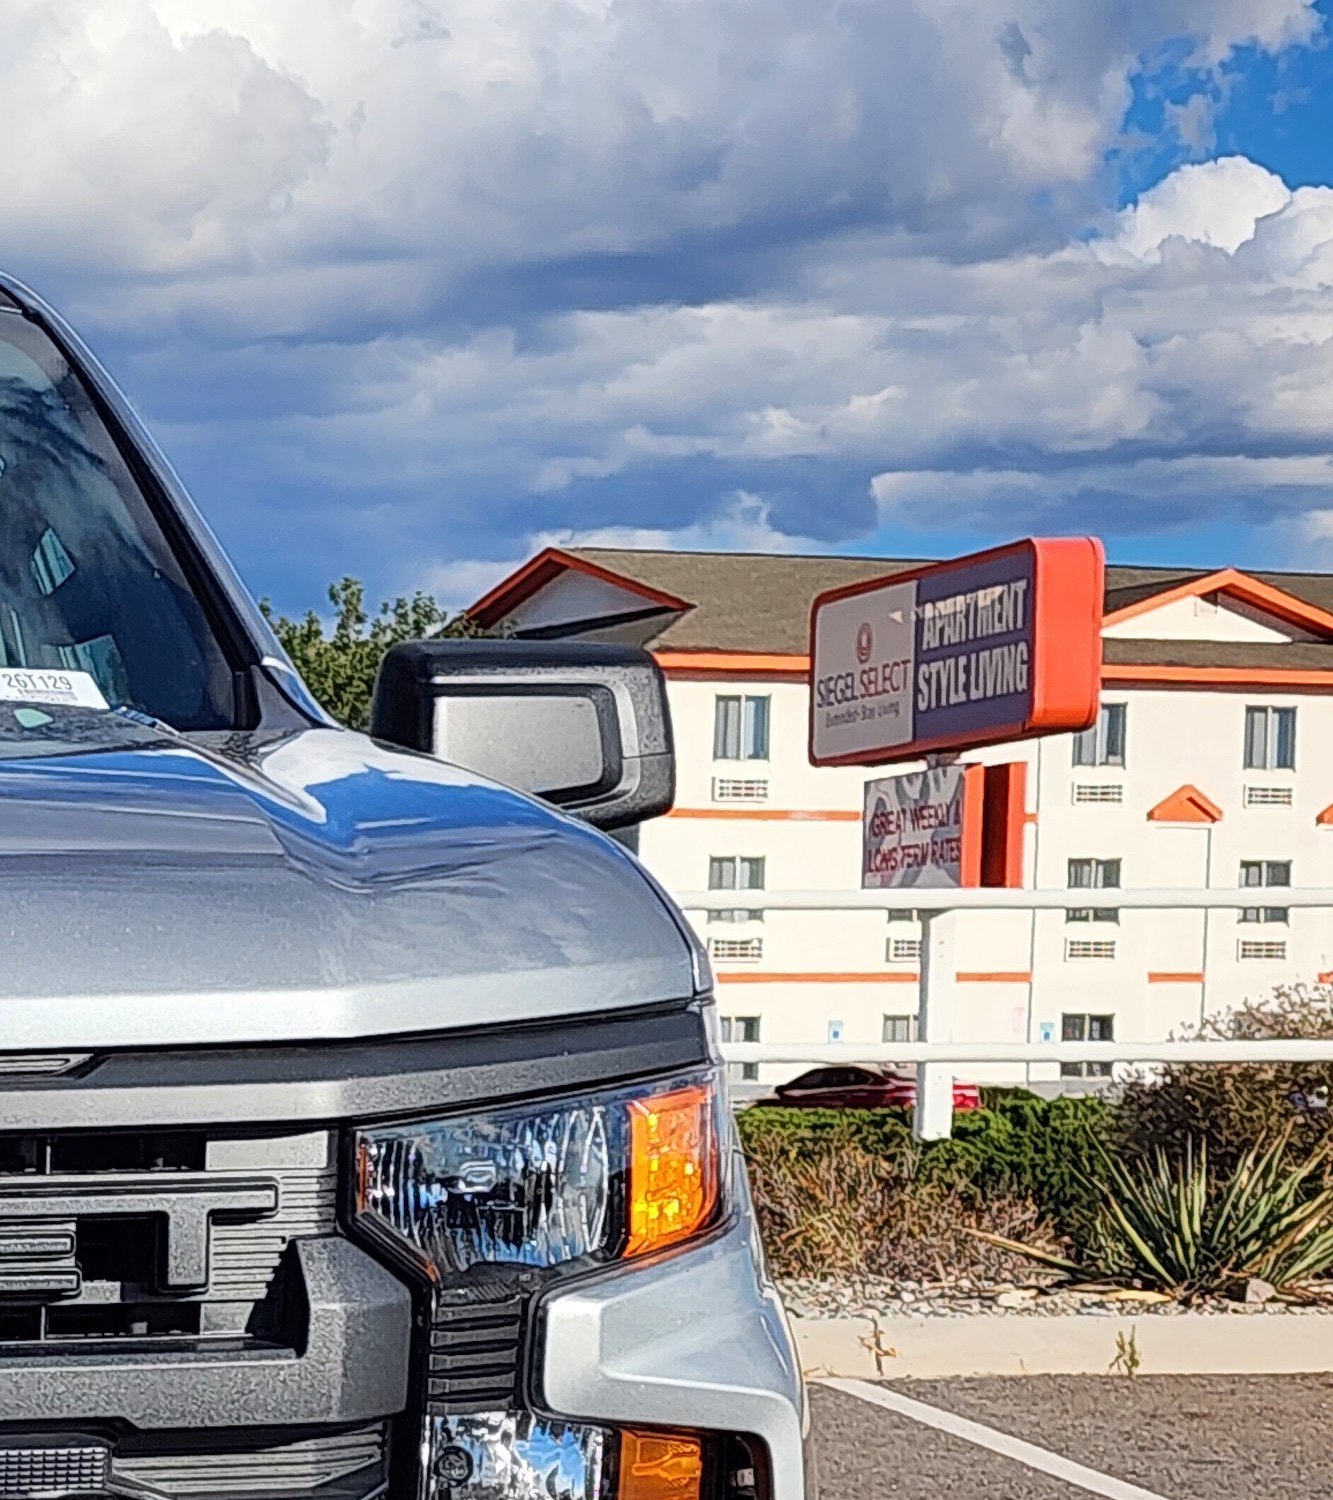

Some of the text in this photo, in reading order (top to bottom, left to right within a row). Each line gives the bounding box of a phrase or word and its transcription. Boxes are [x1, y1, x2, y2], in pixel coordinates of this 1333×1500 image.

[921, 579, 1028, 650] APARTMENT
[1, 672, 73, 691] 26T129
[817, 659, 911, 708] SIEGEL SELECT
[917, 641, 1028, 711] STYLE LIVING
[872, 808, 906, 838] GREAT
